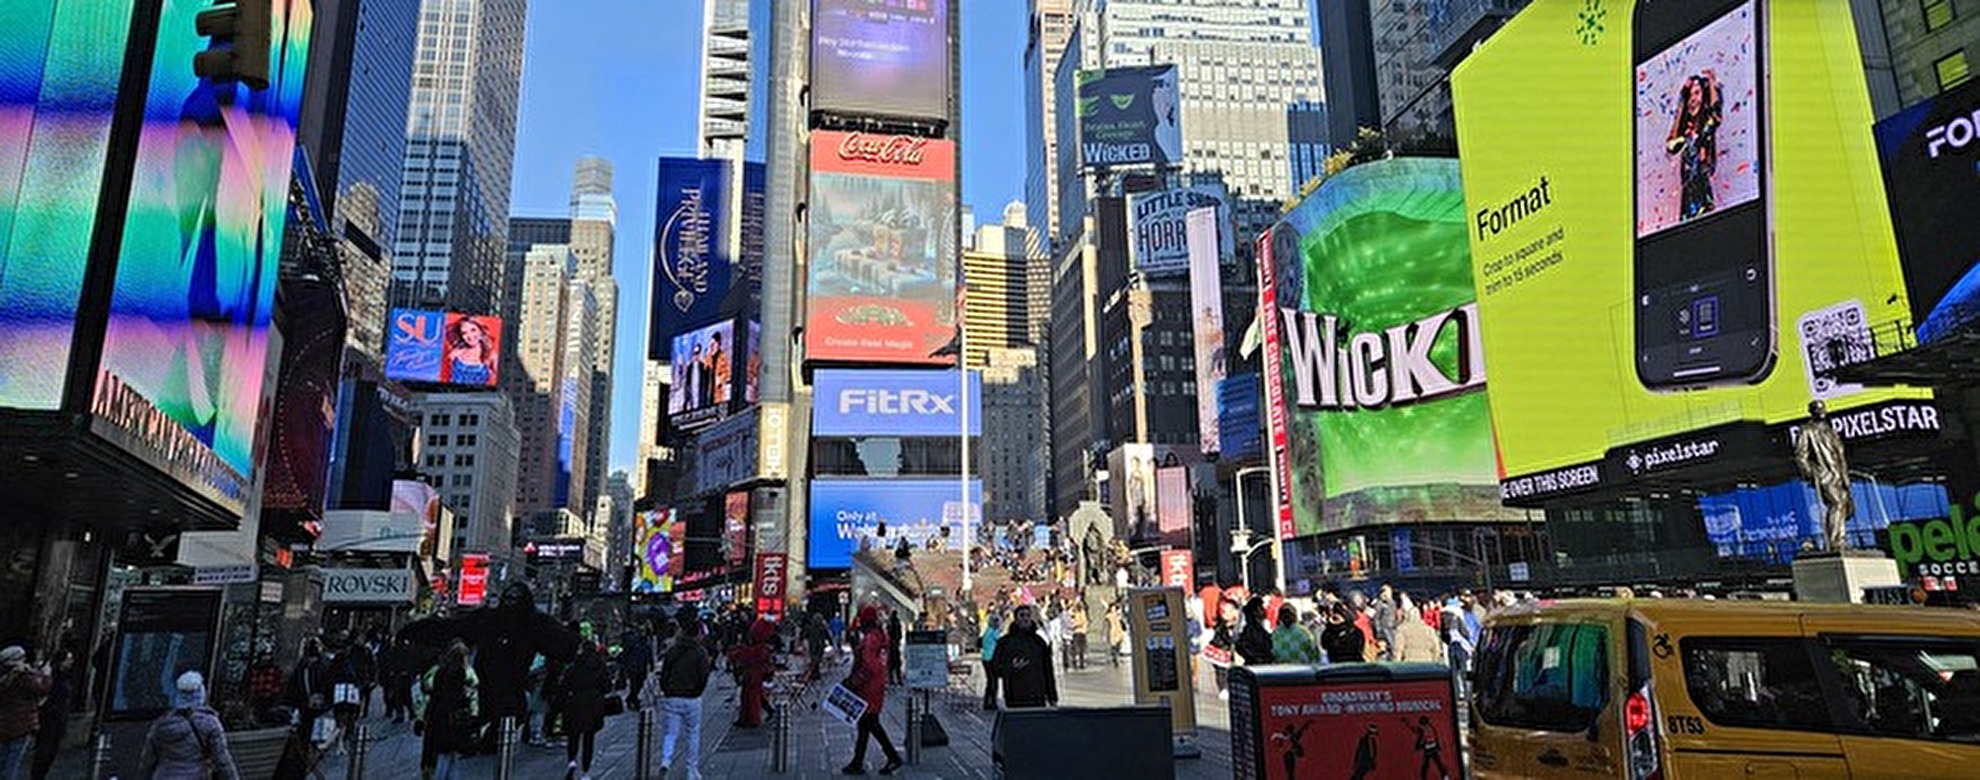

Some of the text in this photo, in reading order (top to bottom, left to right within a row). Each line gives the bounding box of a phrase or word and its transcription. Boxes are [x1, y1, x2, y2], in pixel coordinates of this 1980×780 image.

[838, 131, 927, 165] Coca-Cola
[1137, 191, 1184, 220] LITTLE
[1477, 176, 1551, 241] Format
[1483, 259, 1503, 277] Crop
[1504, 253, 1514, 265] to
[1546, 225, 1565, 246] and
[1503, 274, 1513, 286] to
[825, 336, 913, 350] Create Real Magic
[839, 388, 955, 414] FitRx
[1831, 405, 1940, 438] PIXELSTAR
[1645, 439, 1719, 471] pixelstar
[836, 510, 877, 524] Only at
[327, 575, 408, 594] ROVSKI
[762, 556, 782, 595] tkts
[1169, 555, 1188, 586] tkt
[1668, 715, 1705, 734] 8T53
